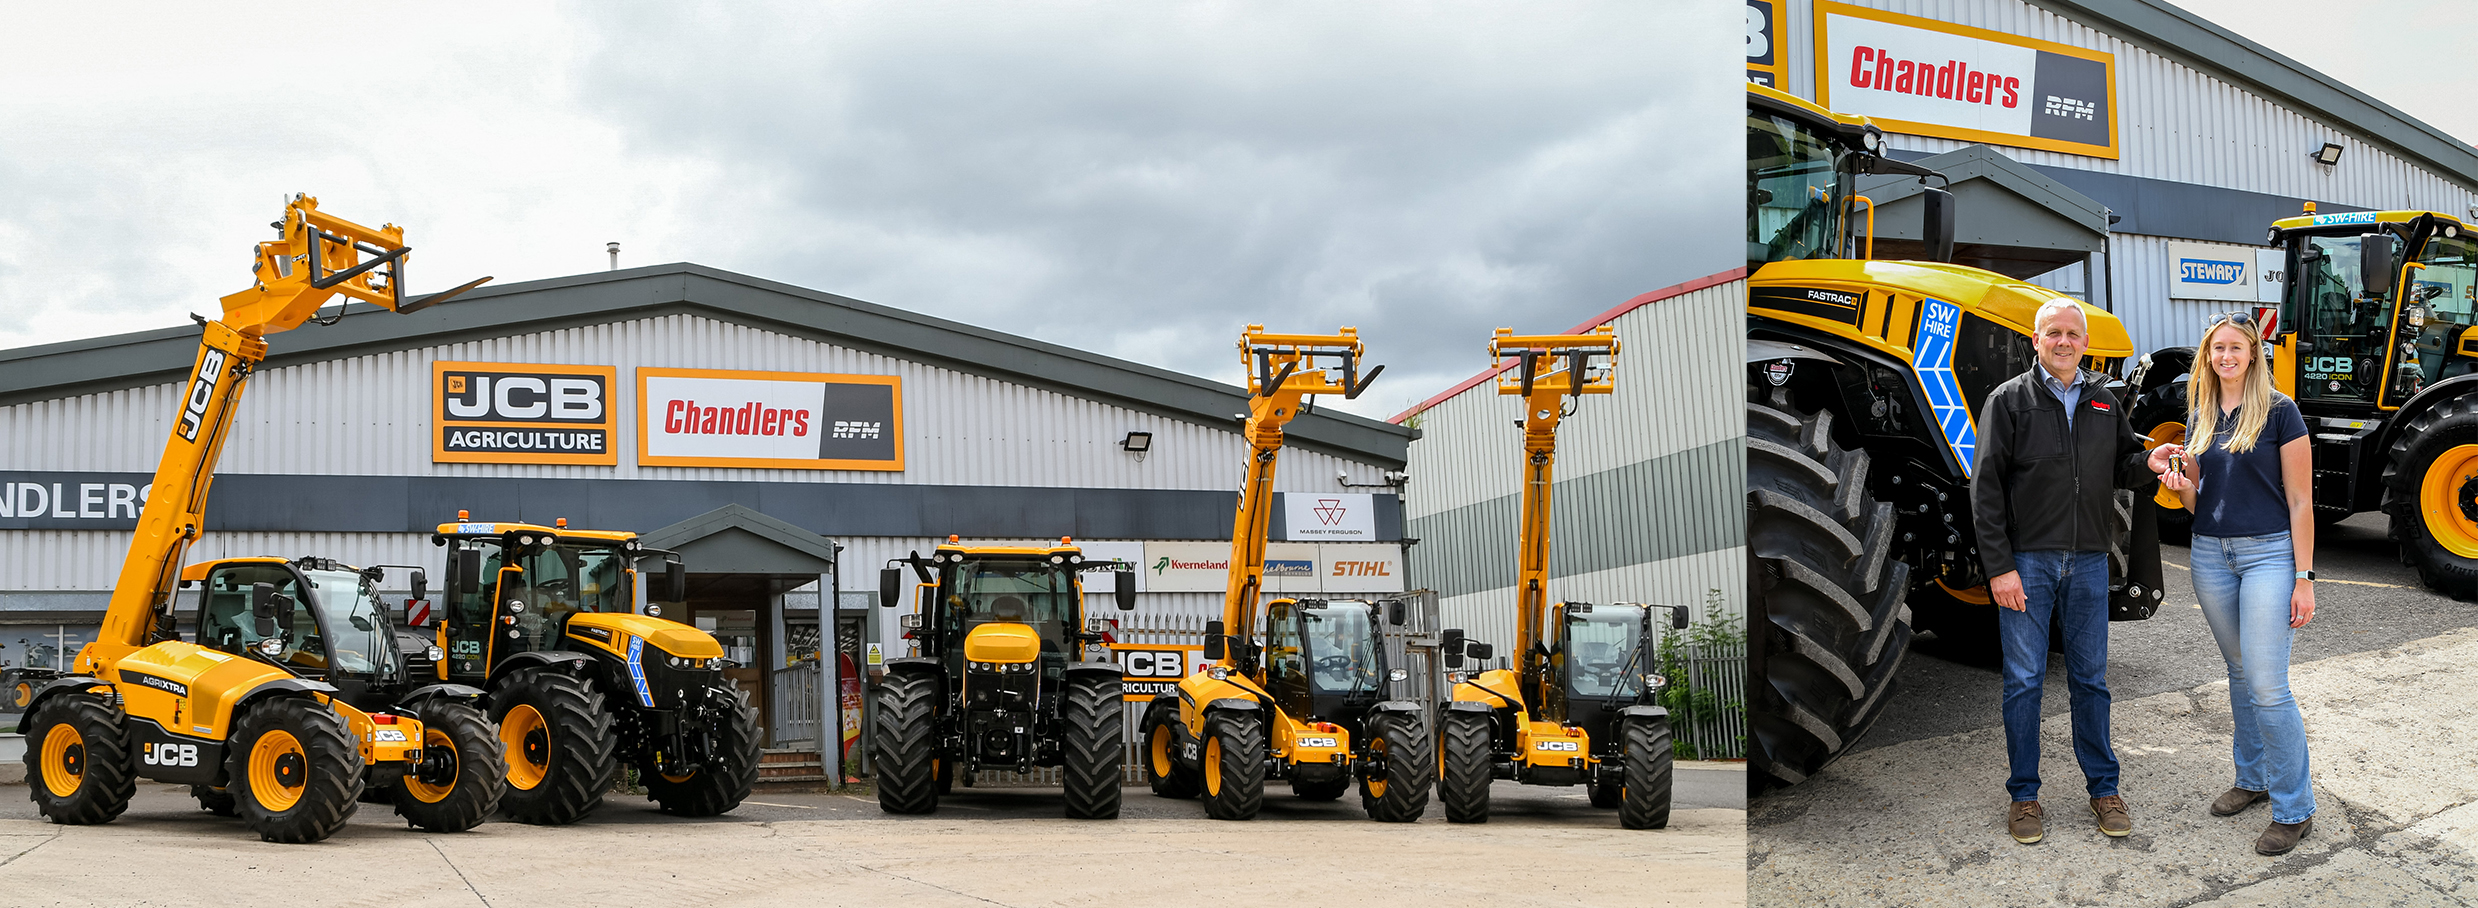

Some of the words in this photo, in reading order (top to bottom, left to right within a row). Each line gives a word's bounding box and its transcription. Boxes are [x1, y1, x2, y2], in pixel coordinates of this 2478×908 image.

[1850, 45, 2019, 110] Chandlers
[2044, 95, 2095, 121] RFM
[2327, 211, 2375, 224] SW-HIRE
[2181, 262, 2242, 282] STEWART
[1808, 290, 1852, 305] FASTRAC
[1928, 302, 1955, 323] SW
[1924, 318, 1952, 338] HIRE
[2304, 356, 2353, 373] JCB
[184, 349, 224, 441] JCB
[448, 376, 602, 420] JCB
[665, 399, 810, 438] Chandlers
[833, 420, 881, 440] RFM
[449, 430, 602, 451] AGRICULTURE
[1171, 560, 1228, 570] Kverneland
[1263, 562, 1311, 573] helbourne
[1332, 561, 1390, 576] STIHL
[451, 641, 480, 654] JCB
[632, 636, 642, 646] SW
[143, 676, 186, 696] AGRIXTRA
[1122, 682, 1178, 693] RICULTUR
[1183, 742, 1197, 760] JCB
[1298, 737, 1337, 747] JCB
[1537, 741, 1577, 751] JCB
[144, 743, 198, 767] JCB
